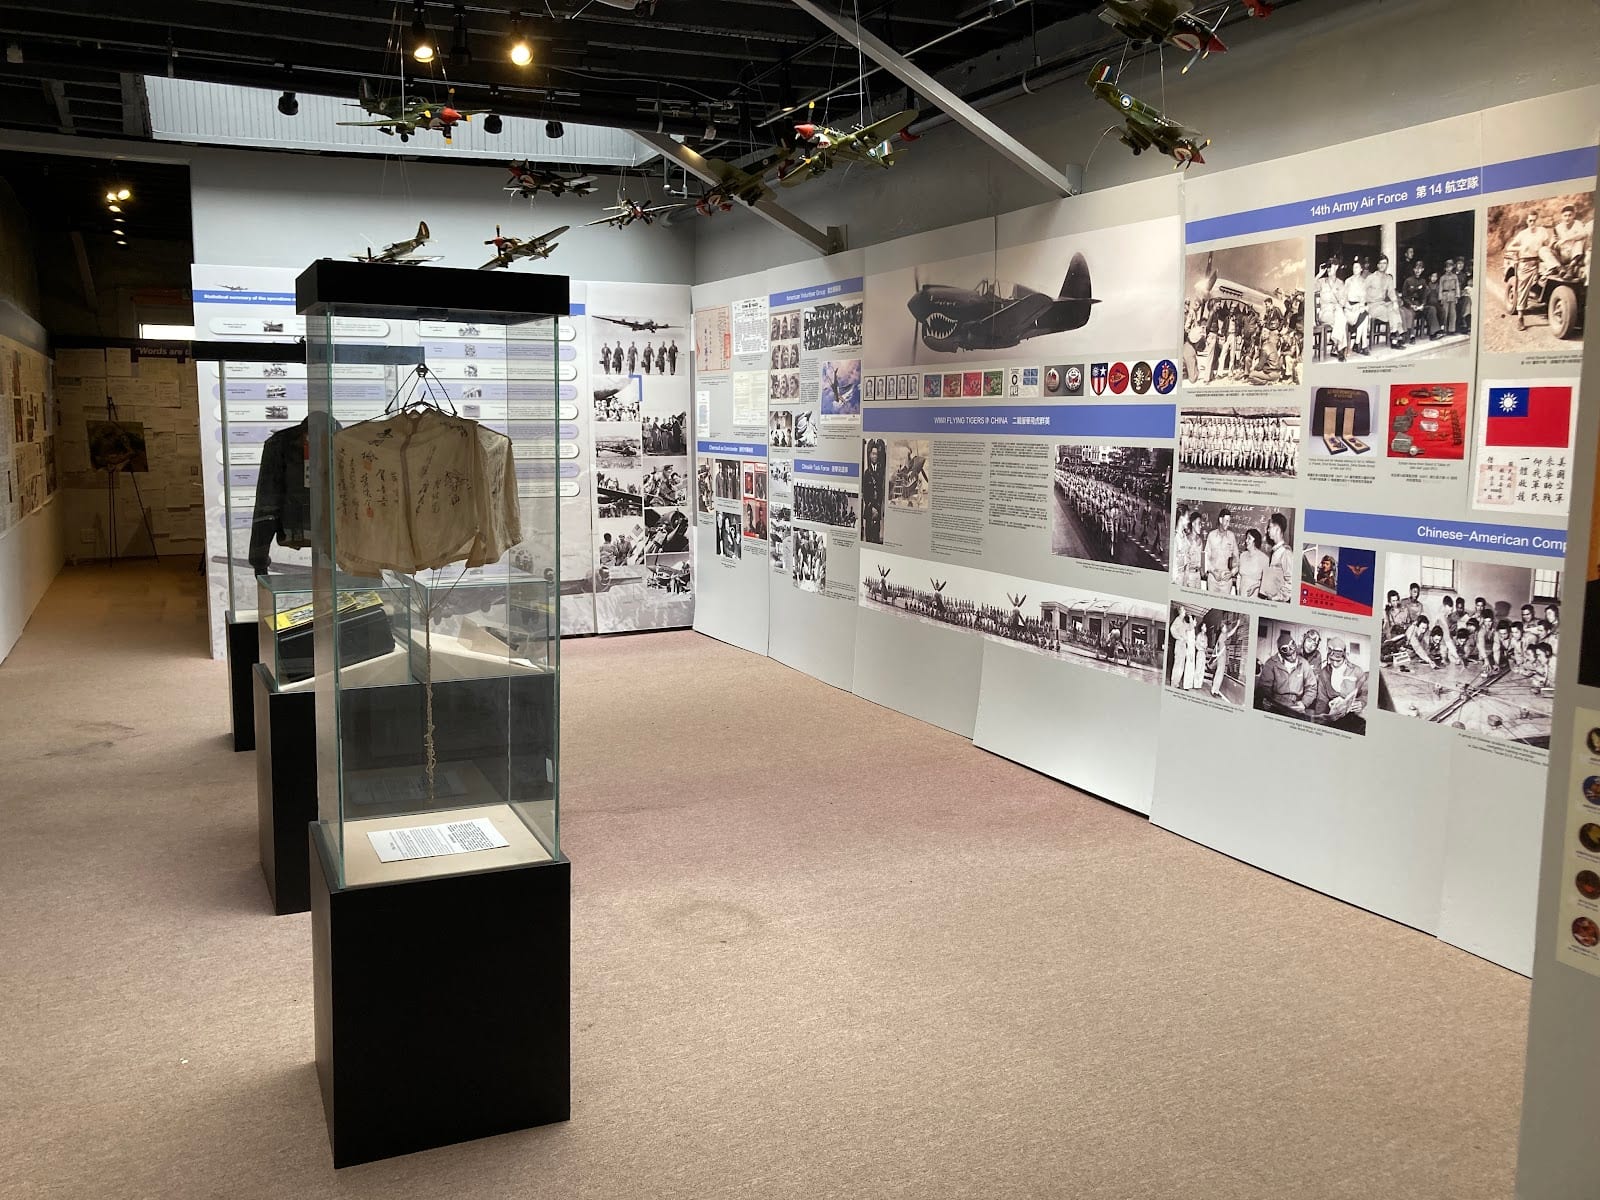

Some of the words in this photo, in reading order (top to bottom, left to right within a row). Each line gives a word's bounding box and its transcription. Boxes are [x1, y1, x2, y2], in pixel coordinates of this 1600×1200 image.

[1416, 186, 1427, 199] 第
[1429, 184, 1442, 196] 14
[1445, 176, 1479, 194] 航空隊
[1310, 204, 1331, 217] 14th
[1332, 201, 1358, 214] Army
[1360, 197, 1375, 208] Air
[1377, 191, 1409, 206] Force
[946, 417, 965, 425] FLYING
[966, 417, 985, 425] TIGERS
[990, 417, 1009, 425] CHINA
[1417, 525, 1529, 547] Chinese-American
